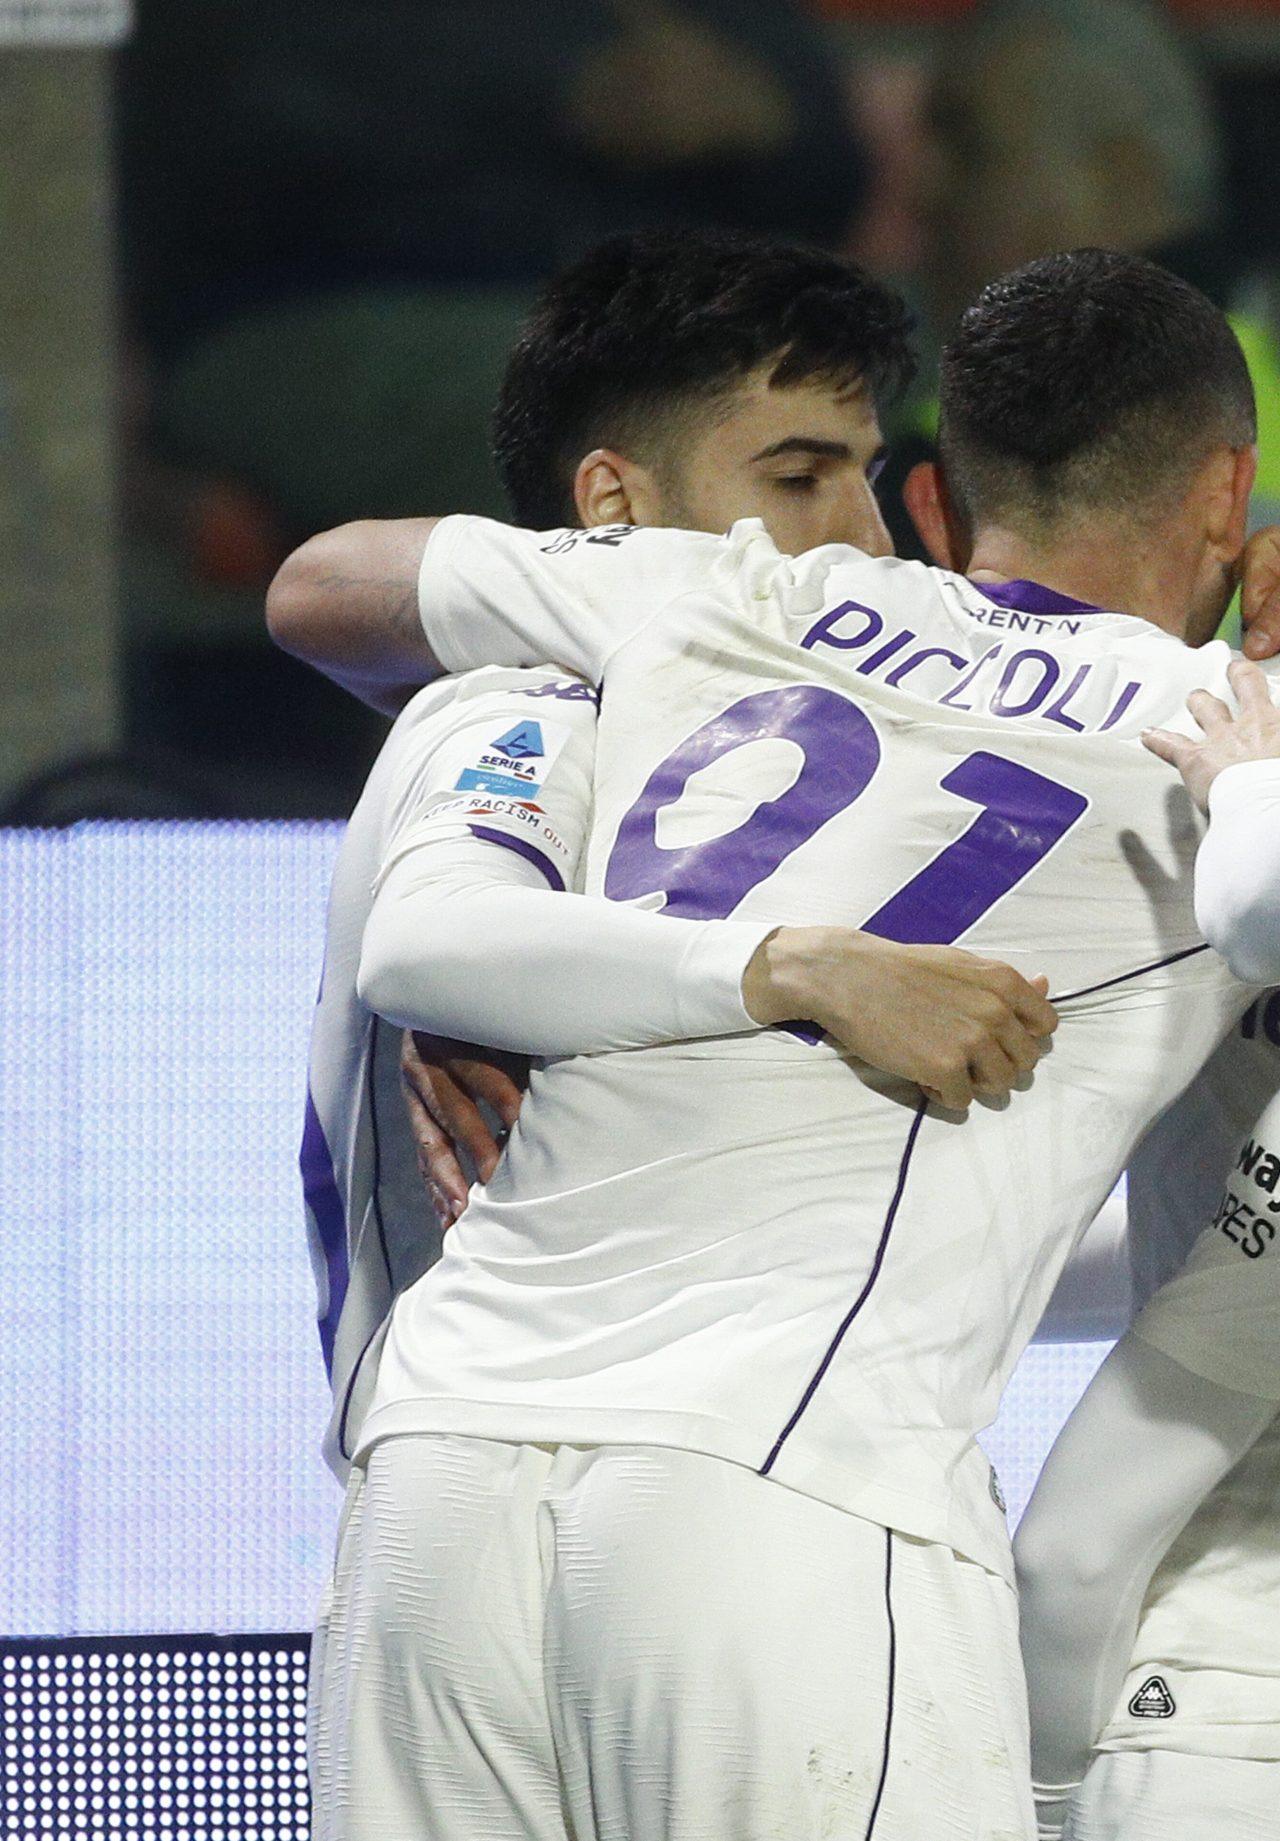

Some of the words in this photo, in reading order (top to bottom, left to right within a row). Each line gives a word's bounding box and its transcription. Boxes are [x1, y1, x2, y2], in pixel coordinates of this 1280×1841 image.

[480, 754, 522, 772] SERIE
[524, 766, 537, 777] A
[469, 798, 540, 828] RACISM
[604, 684, 1089, 946] 91
